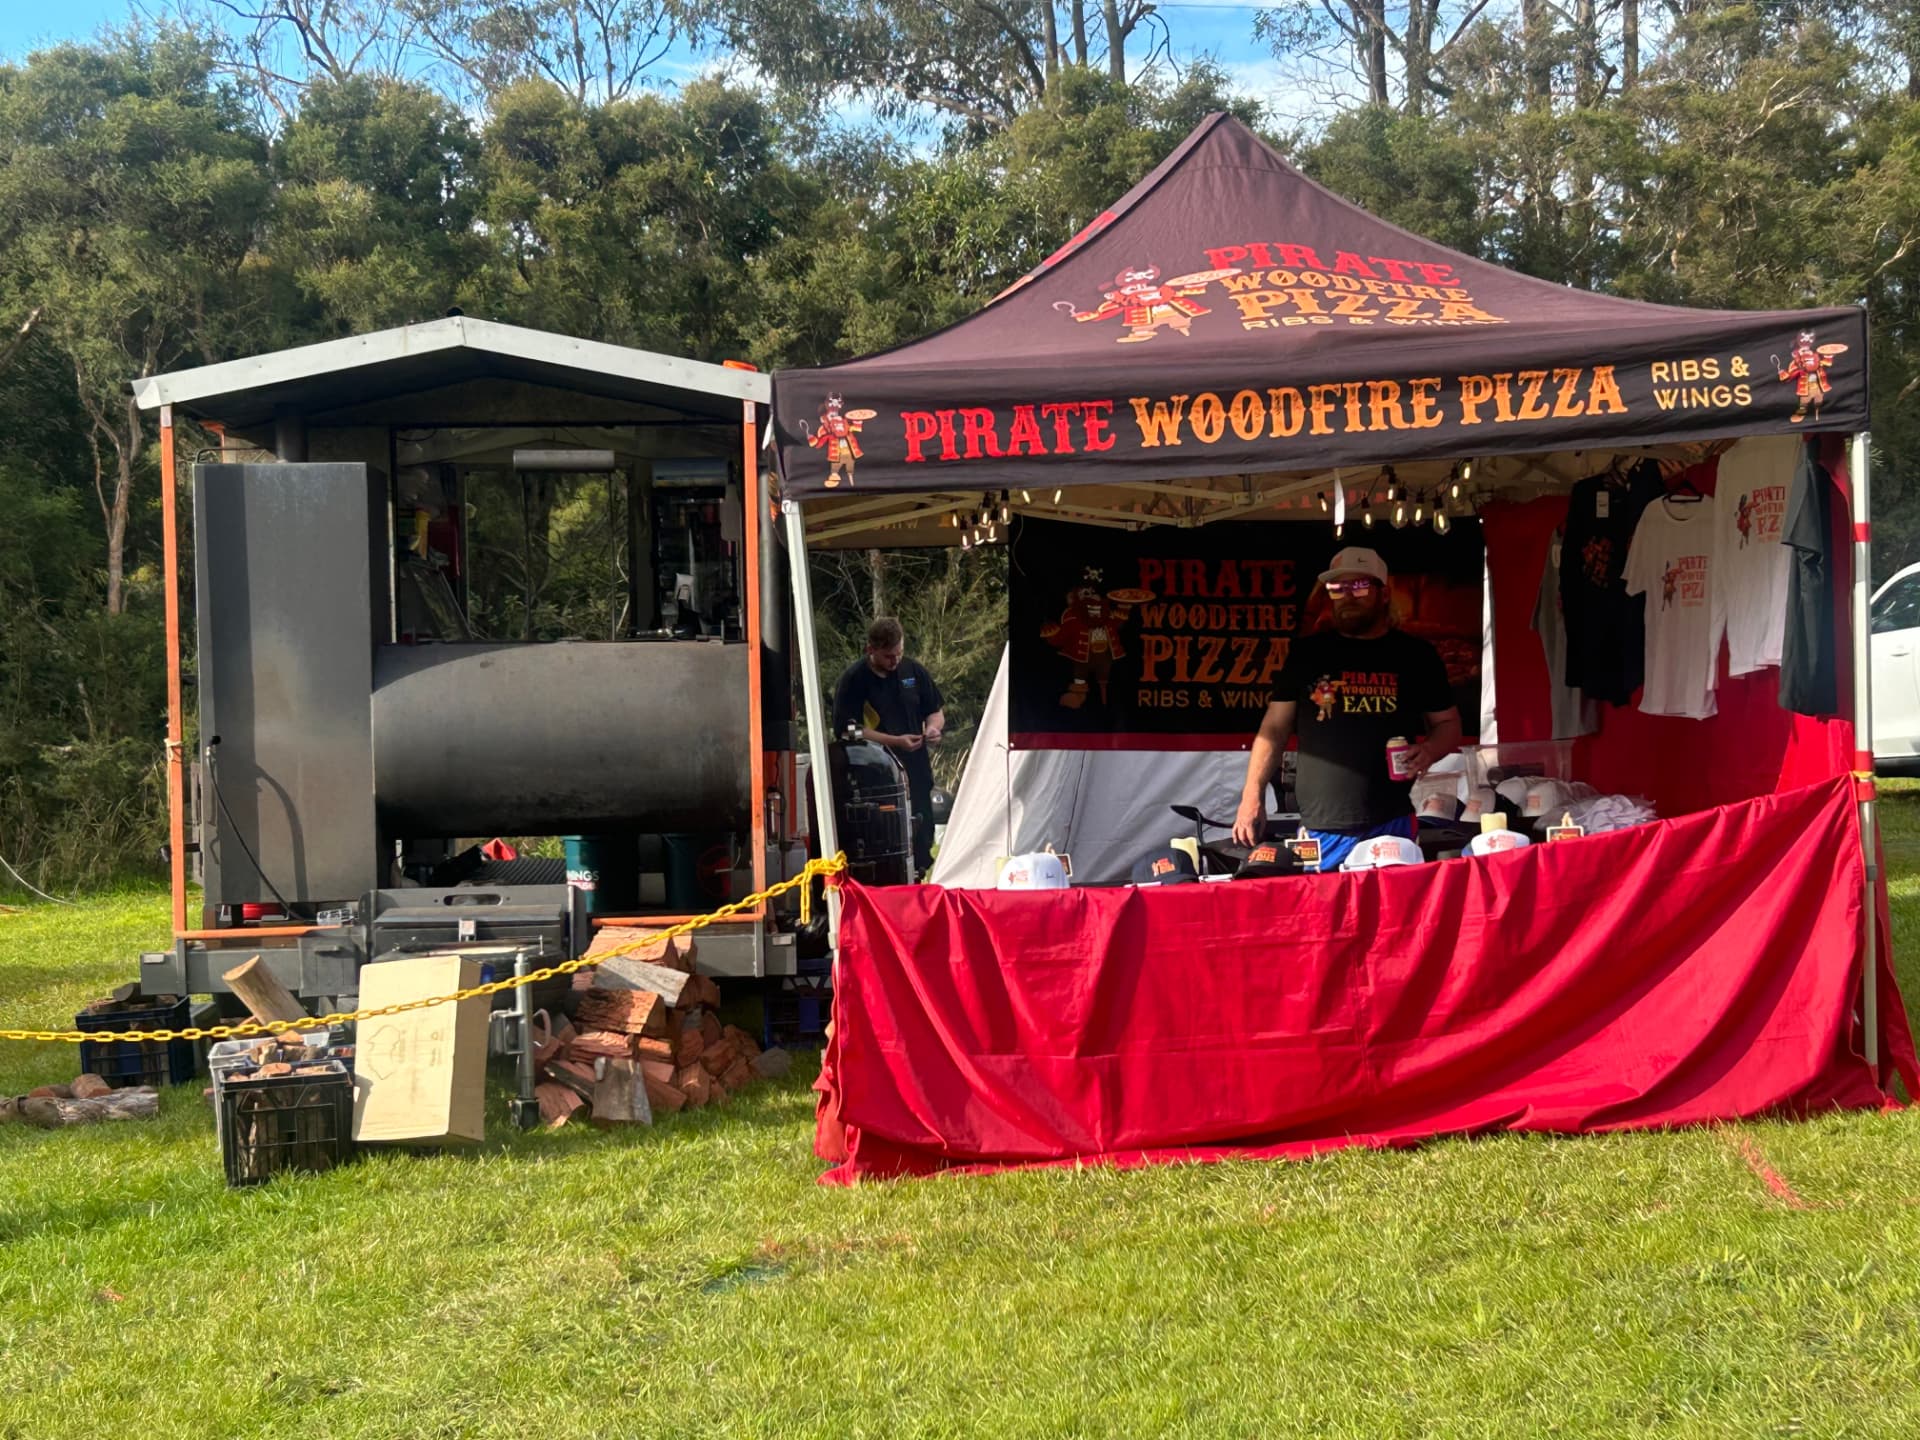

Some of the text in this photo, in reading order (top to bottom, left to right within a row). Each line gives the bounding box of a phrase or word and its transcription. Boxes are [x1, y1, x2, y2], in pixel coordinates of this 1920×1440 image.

[1205, 242, 1460, 286] PIRATE
[1219, 269, 1474, 302] WOODFIRE
[1229, 289, 1505, 321] PIZZA
[1241, 315, 1334, 331] RIBS
[1650, 355, 1751, 384] RIBS &
[1653, 384, 1752, 412] WINGS
[900, 365, 1629, 463] PIRATE WOODFIRE PIZZA
[1137, 558, 1297, 598] PIRATE
[1140, 603, 1297, 631] WOODFIRE
[1138, 634, 1291, 684] PIZZA
[1341, 671, 1398, 686] PIRATE
[1341, 686, 1398, 697] WOODFIRE
[1138, 689, 1273, 708] RIBS & WIN
[1343, 696, 1398, 713] EATS
